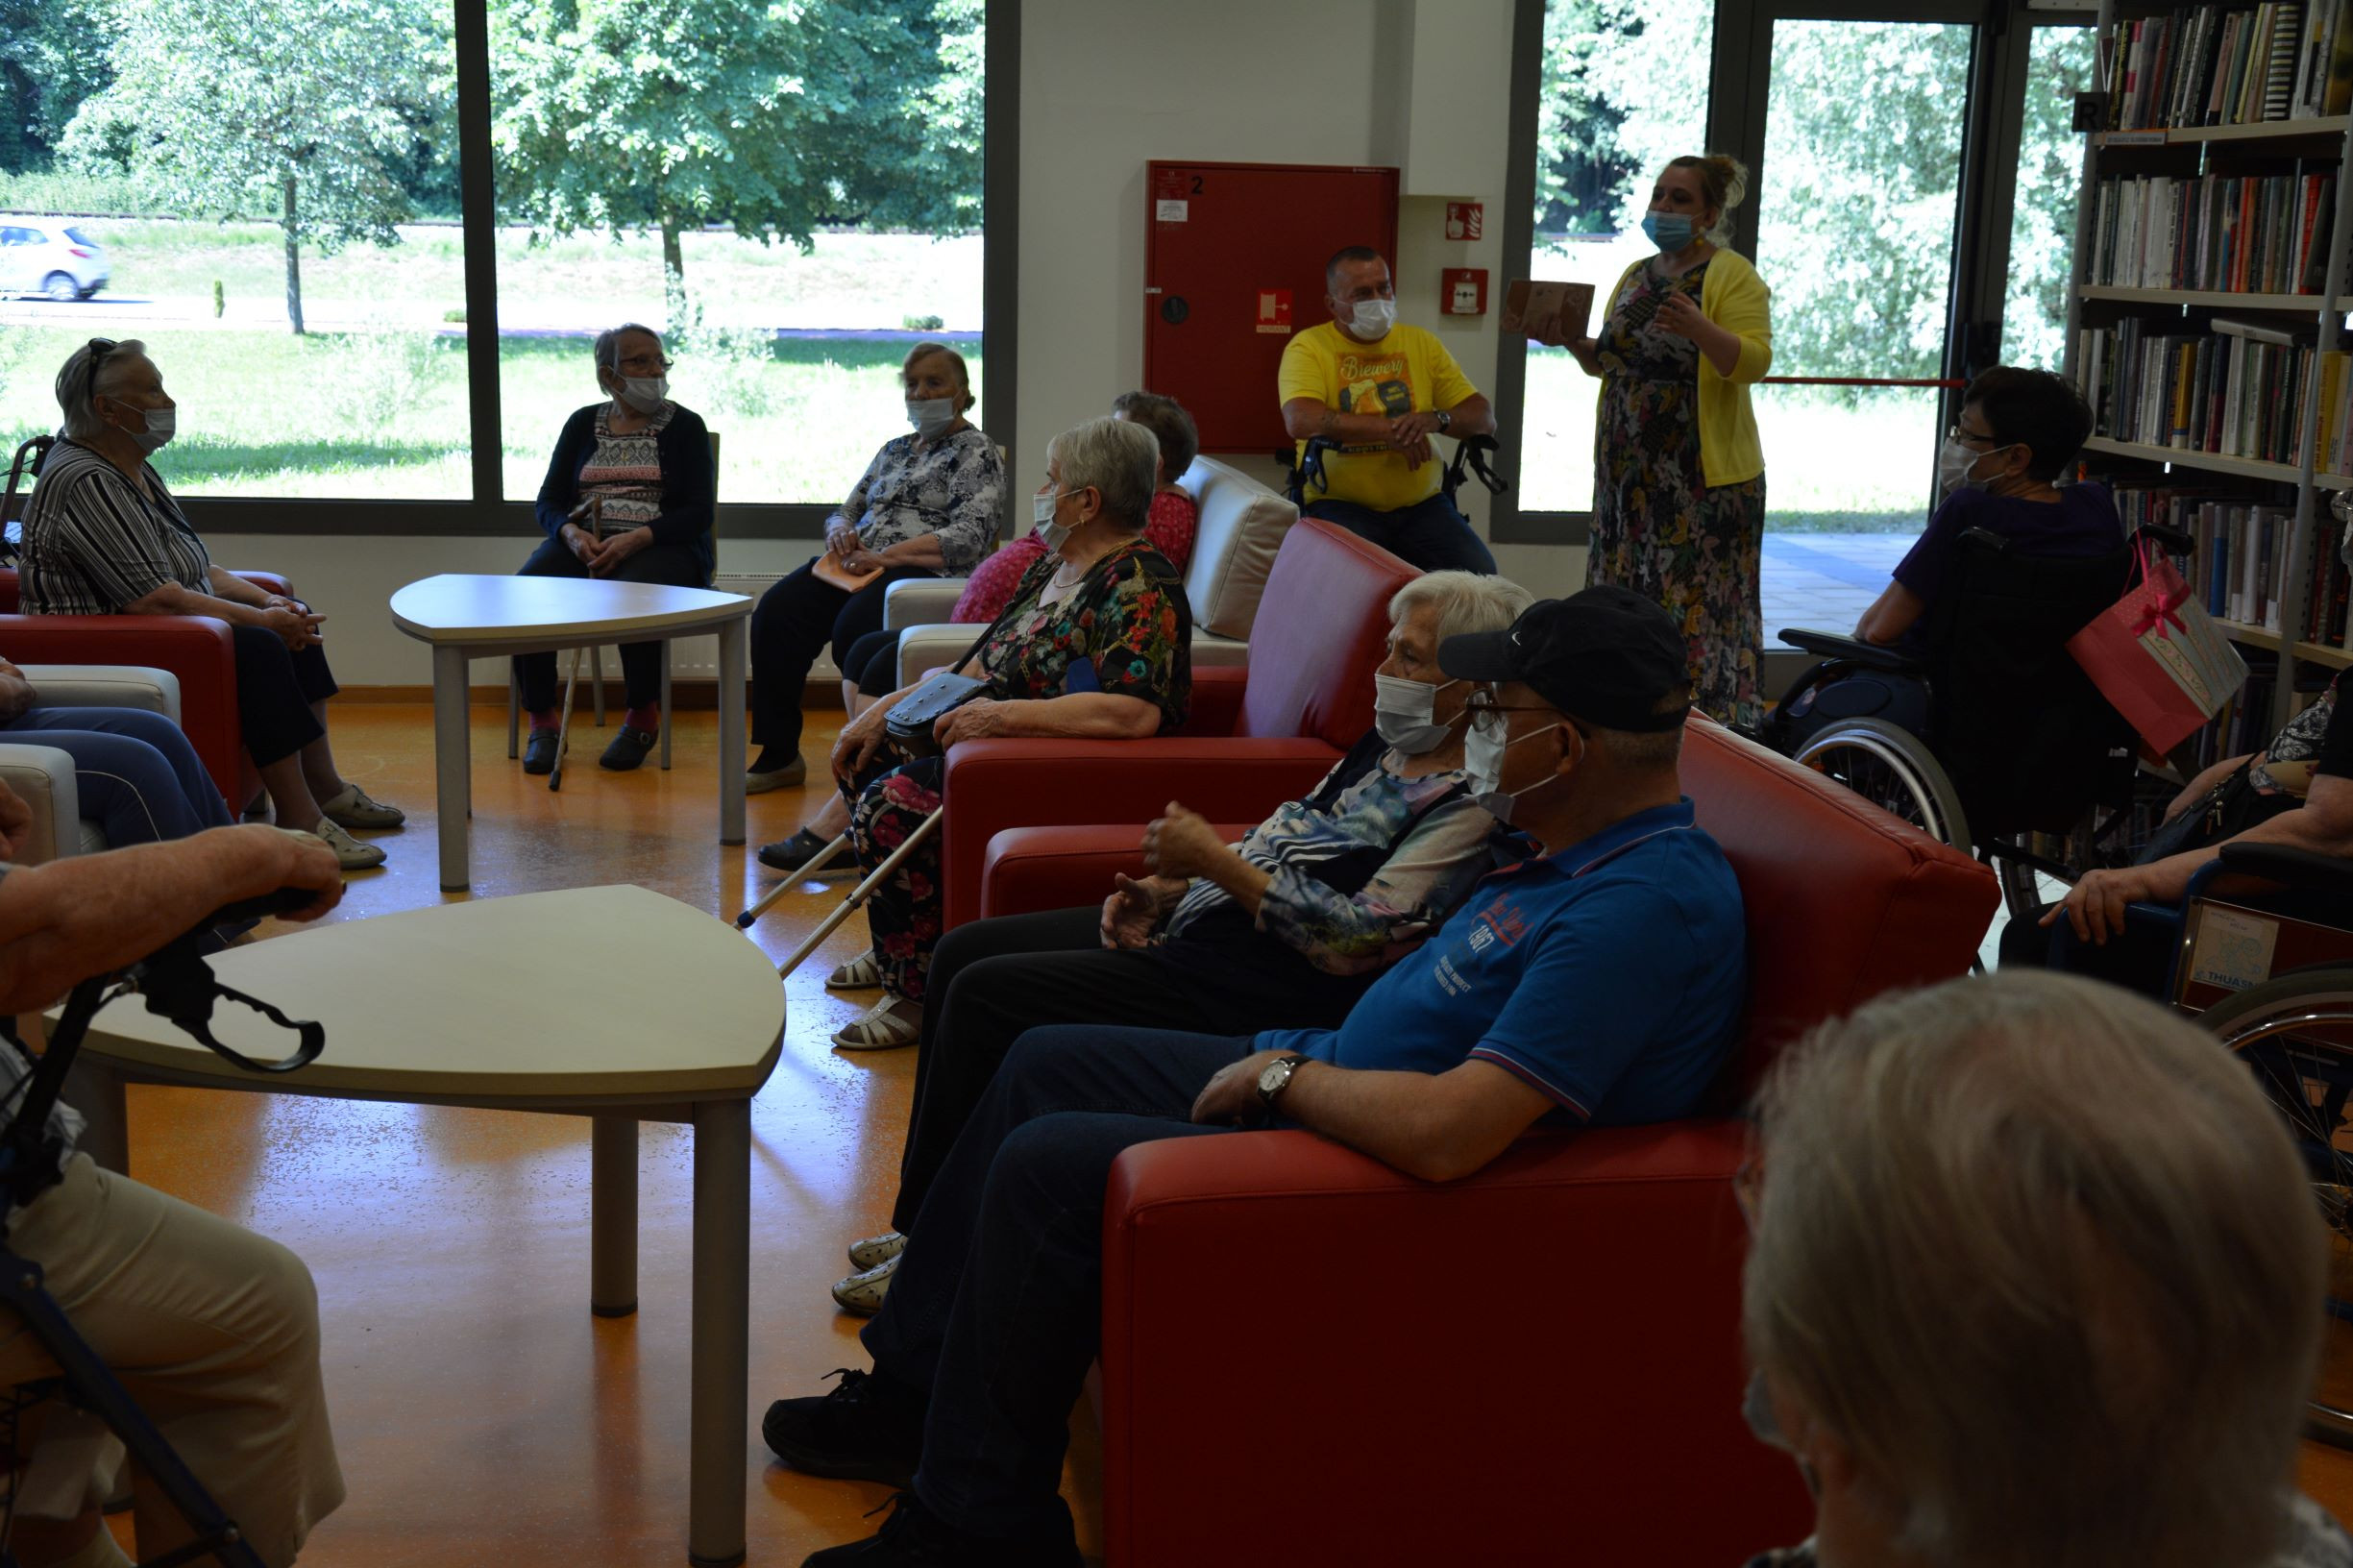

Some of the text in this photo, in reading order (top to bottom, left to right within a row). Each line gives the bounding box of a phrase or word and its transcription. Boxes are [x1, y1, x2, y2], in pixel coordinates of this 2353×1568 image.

[2078, 102, 2099, 129] R
[1191, 175, 1204, 195] 2
[1340, 355, 1403, 380] Brewery
[1468, 924, 1494, 953] 1967
[2209, 971, 2258, 992] THUASN
